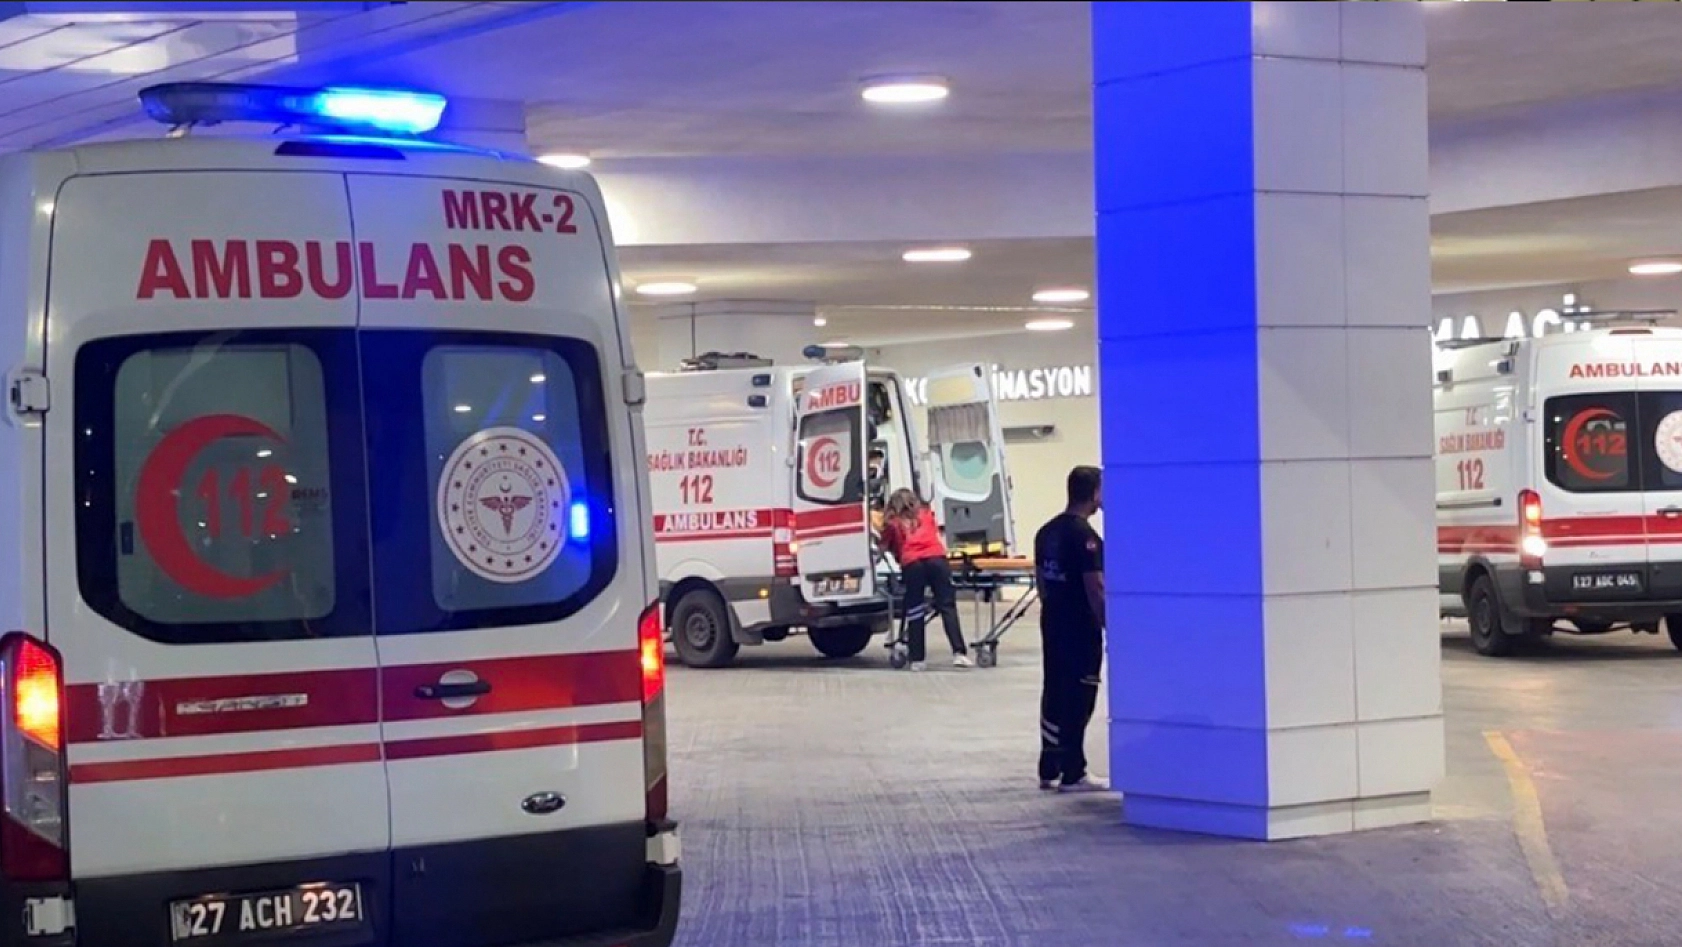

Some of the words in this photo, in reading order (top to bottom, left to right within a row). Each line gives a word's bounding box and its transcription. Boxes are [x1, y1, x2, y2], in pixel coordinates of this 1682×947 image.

[442, 189, 577, 234] MRK-2
[136, 238, 535, 302] AMBULANS
[1569, 362, 1682, 378] AMBULAN
[808, 382, 861, 411] AMBU
[688, 444, 748, 469] BAKANLIĞI
[1577, 433, 1626, 455] 112
[818, 450, 841, 473] 112
[1457, 458, 1484, 490] 112
[196, 463, 291, 538] 112
[679, 474, 713, 505] 112
[663, 510, 758, 533] AMBULANS
[190, 901, 226, 935] 27
[239, 895, 293, 930] ACH
[302, 888, 355, 923] 232
